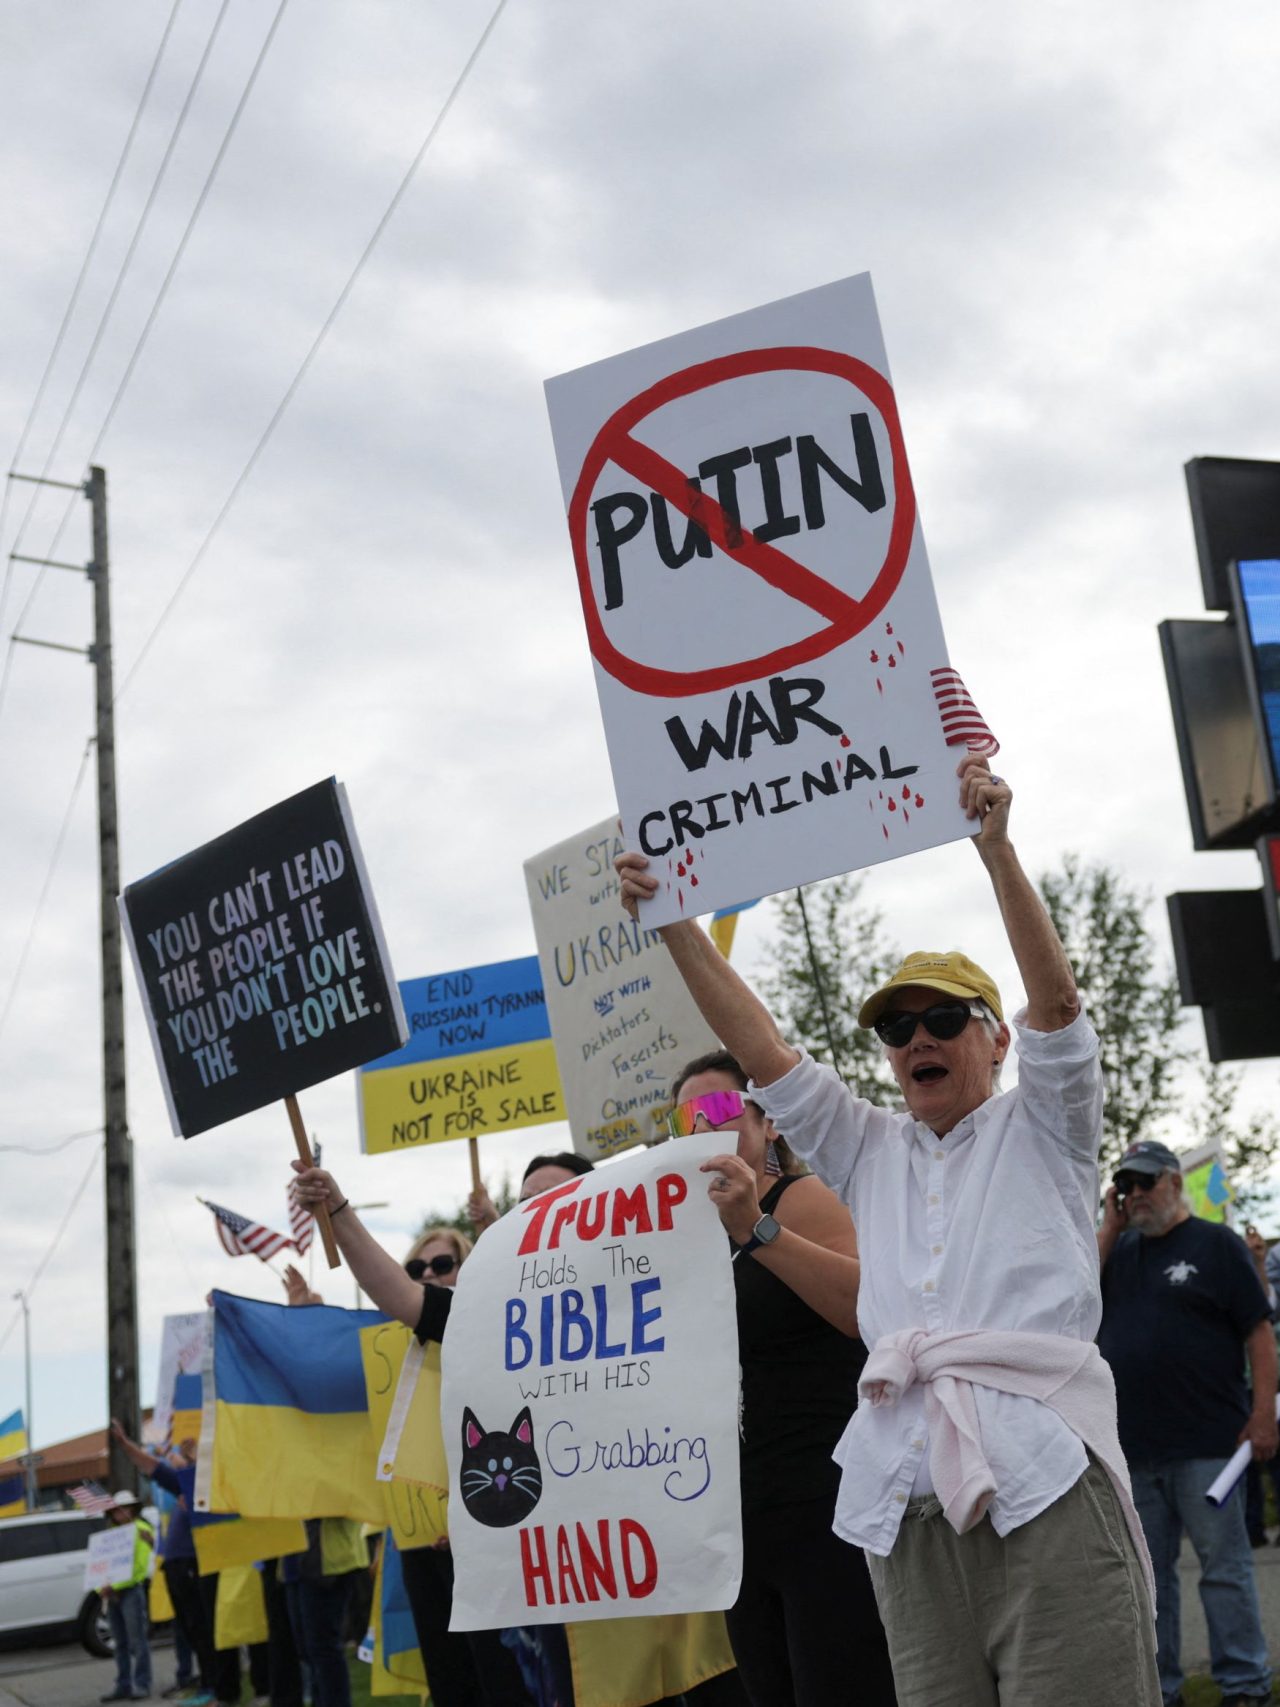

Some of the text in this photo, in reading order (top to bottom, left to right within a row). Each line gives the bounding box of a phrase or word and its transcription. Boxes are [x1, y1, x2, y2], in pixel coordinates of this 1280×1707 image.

[590, 412, 888, 611] PUTIN
[664, 677, 843, 773] WAR
[638, 746, 919, 857] CRIMINAL
[147, 839, 346, 969] YOU CAN'T LEAD
[538, 837, 624, 900] WE STA
[158, 895, 325, 1012] THE PEOPLE IF
[167, 927, 367, 1054] YOU DON'T LOVE
[427, 972, 474, 1004] END
[555, 919, 665, 987] UKRAIN
[594, 975, 652, 1012] NOT WITH
[192, 976, 382, 1088] THE PEOPLE.
[411, 988, 546, 1035] RUSSIAN TYRANN
[439, 1021, 486, 1048] NOW
[392, 1092, 556, 1145] NOT FOR SALE
[519, 1244, 652, 1292] Holds The
[505, 1276, 665, 1372] BIBLE
[519, 1361, 651, 1399] WITH HIS
[546, 1420, 711, 1501] Grabbing
[519, 1518, 658, 1607] HAND
